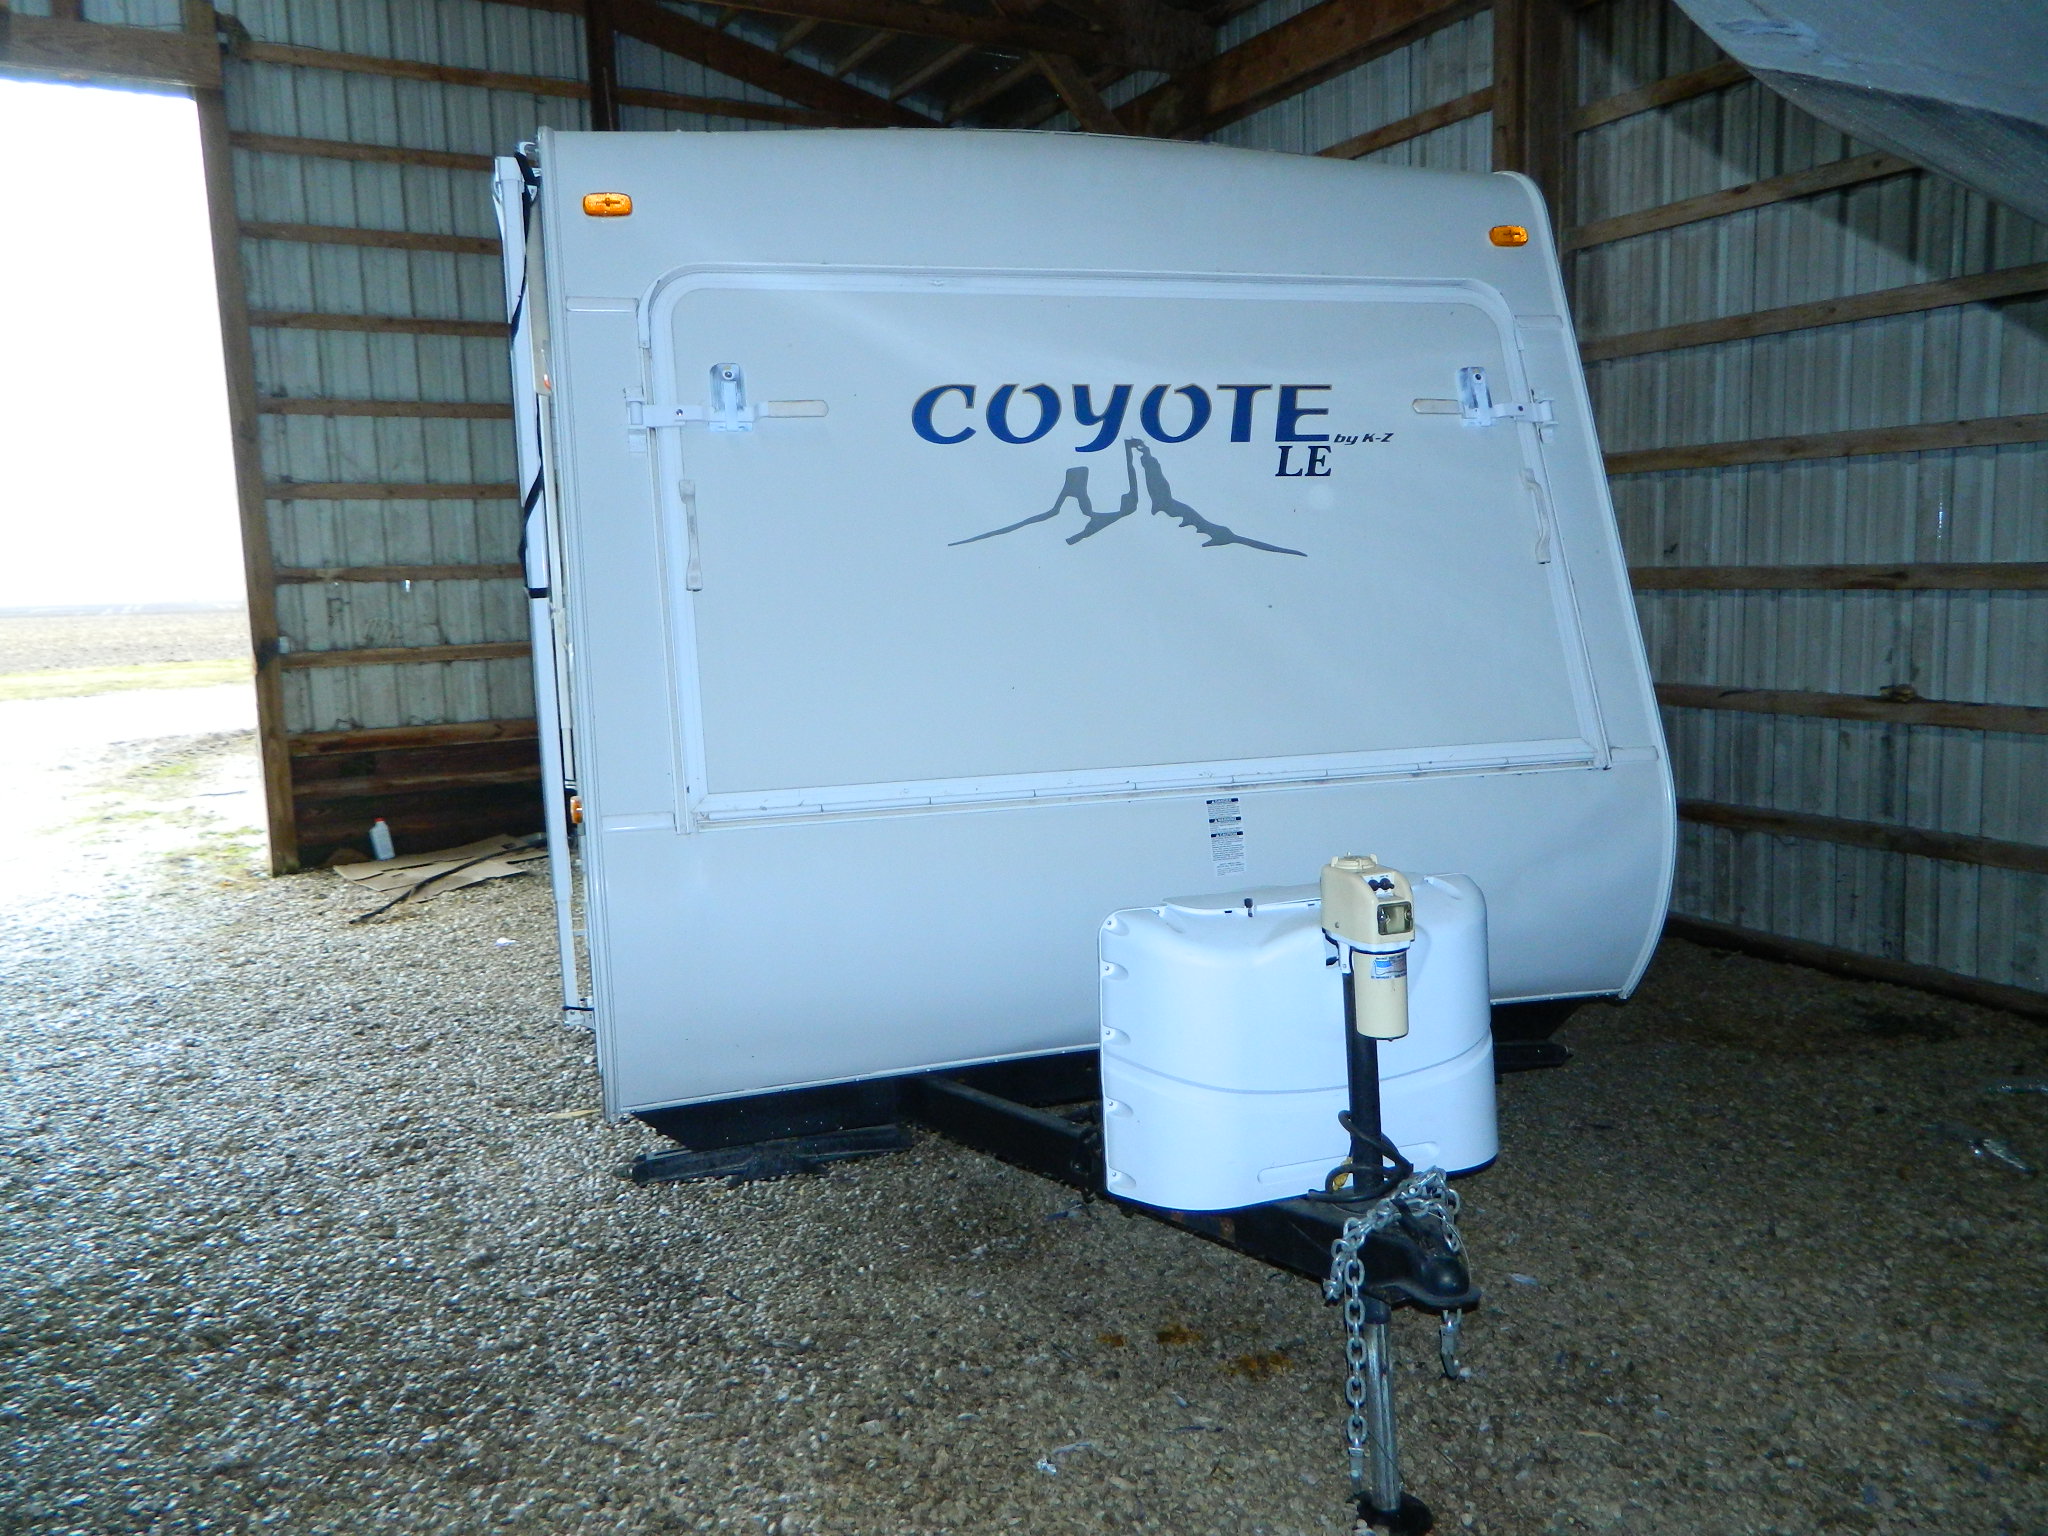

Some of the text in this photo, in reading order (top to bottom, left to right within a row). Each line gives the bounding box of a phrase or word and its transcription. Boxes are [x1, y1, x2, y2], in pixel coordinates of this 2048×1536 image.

[911, 382, 1332, 452] COYOTE
[1333, 432, 1394, 446] by K-Z
[1275, 445, 1332, 477] LE
